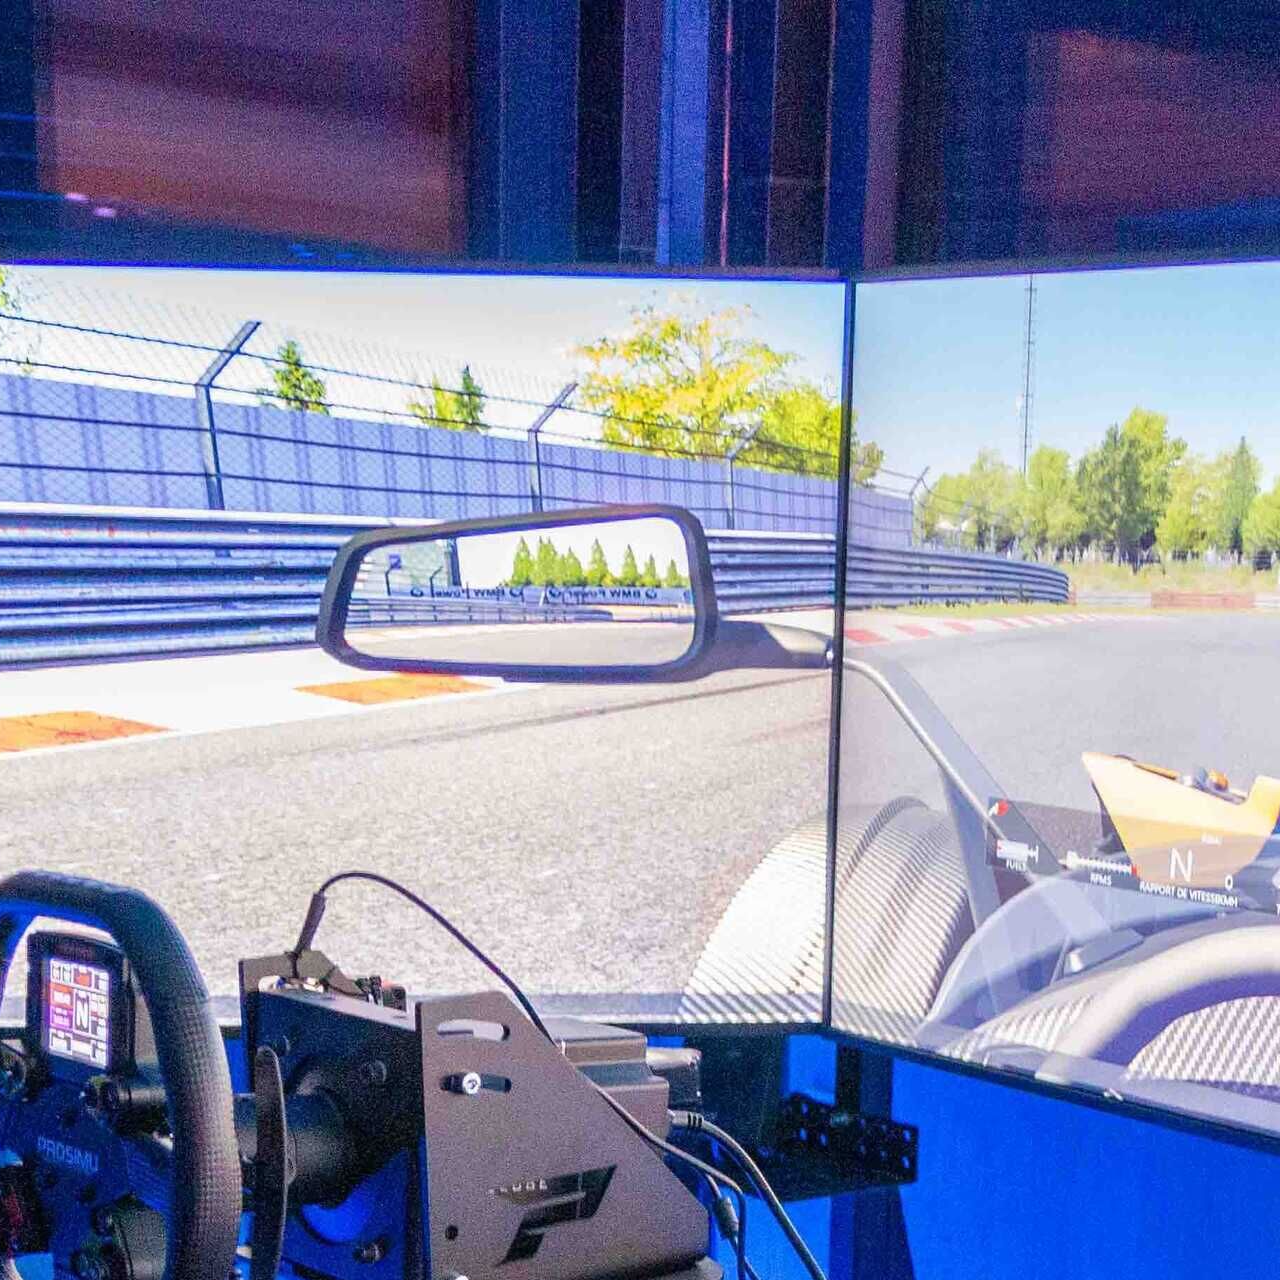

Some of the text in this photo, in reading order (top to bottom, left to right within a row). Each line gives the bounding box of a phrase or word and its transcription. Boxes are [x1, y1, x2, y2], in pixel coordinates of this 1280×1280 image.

[1170, 848, 1193, 883] N
[1140, 880, 1175, 897] RAPPORT
[1224, 874, 1234, 891] 0
